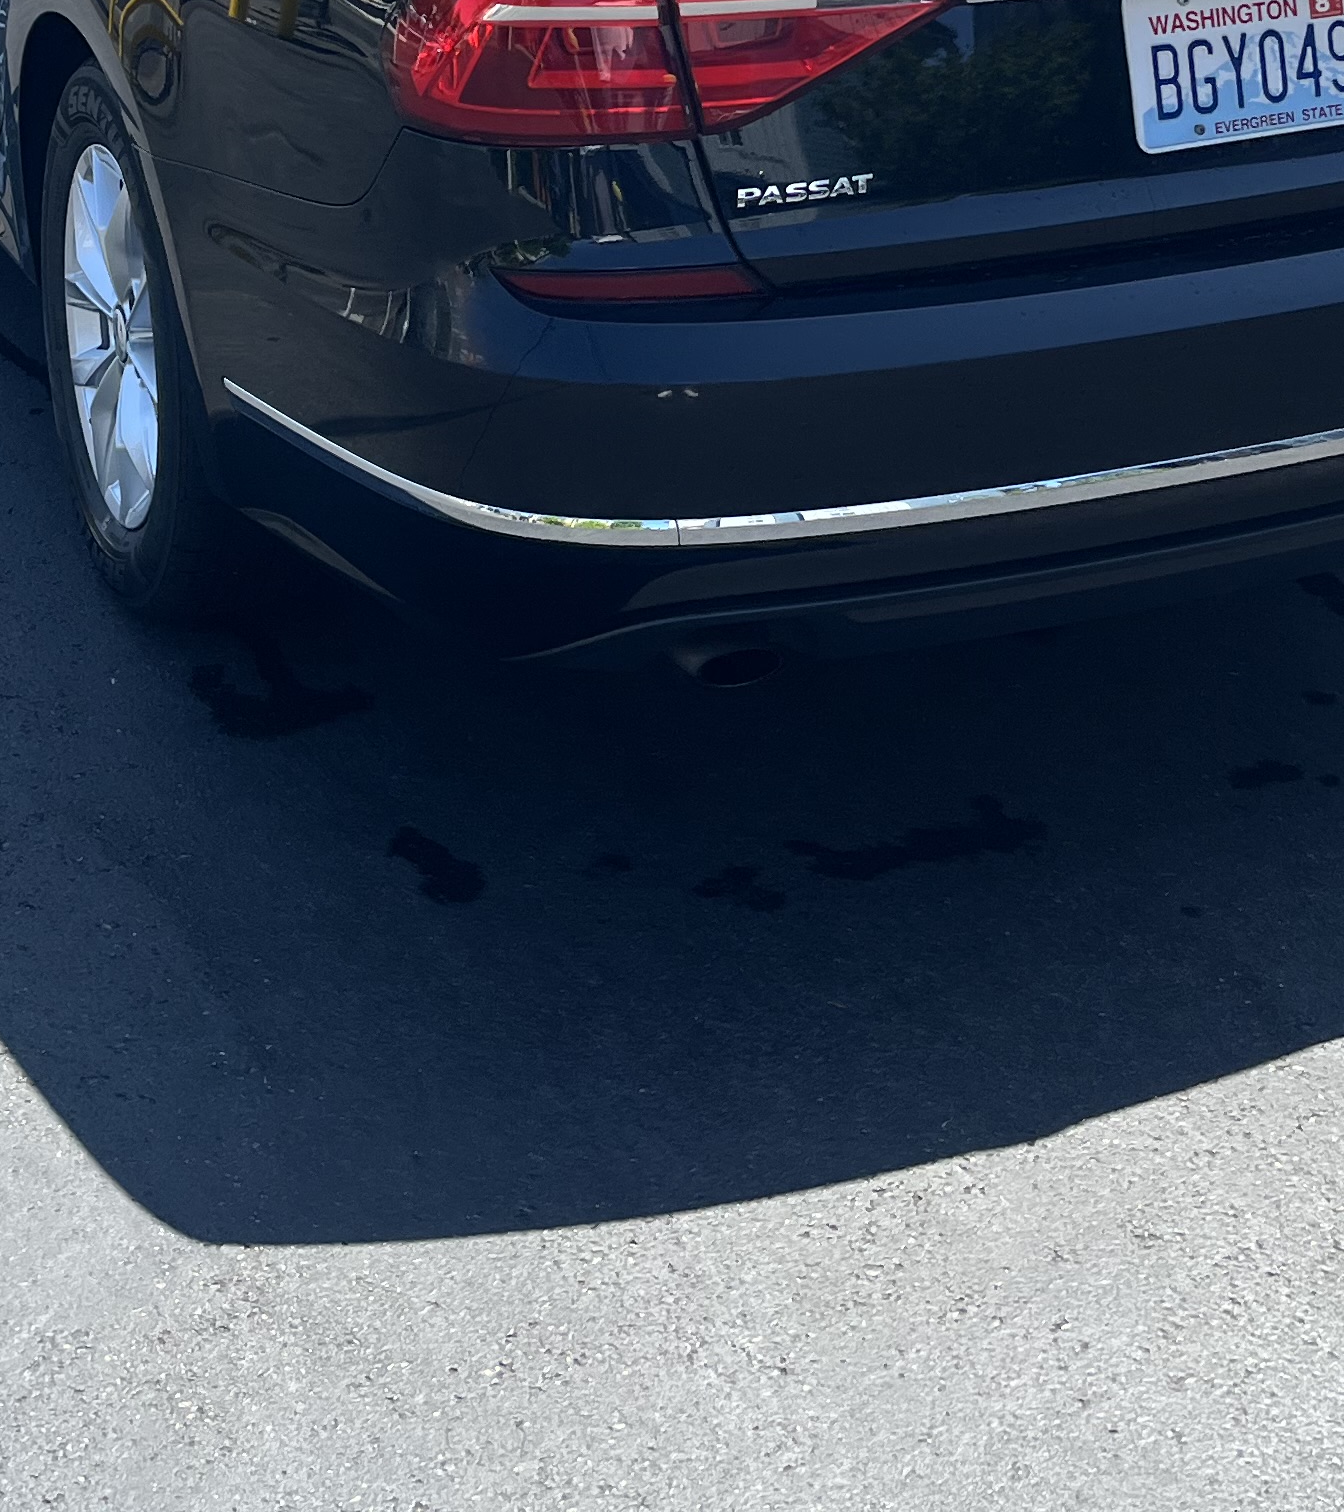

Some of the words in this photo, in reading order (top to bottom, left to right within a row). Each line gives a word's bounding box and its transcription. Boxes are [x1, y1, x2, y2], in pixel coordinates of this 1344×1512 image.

[1214, 110, 1296, 135] EVERGREEN
[1301, 103, 1344, 121] STATE
[736, 172, 874, 209] PASSAT
